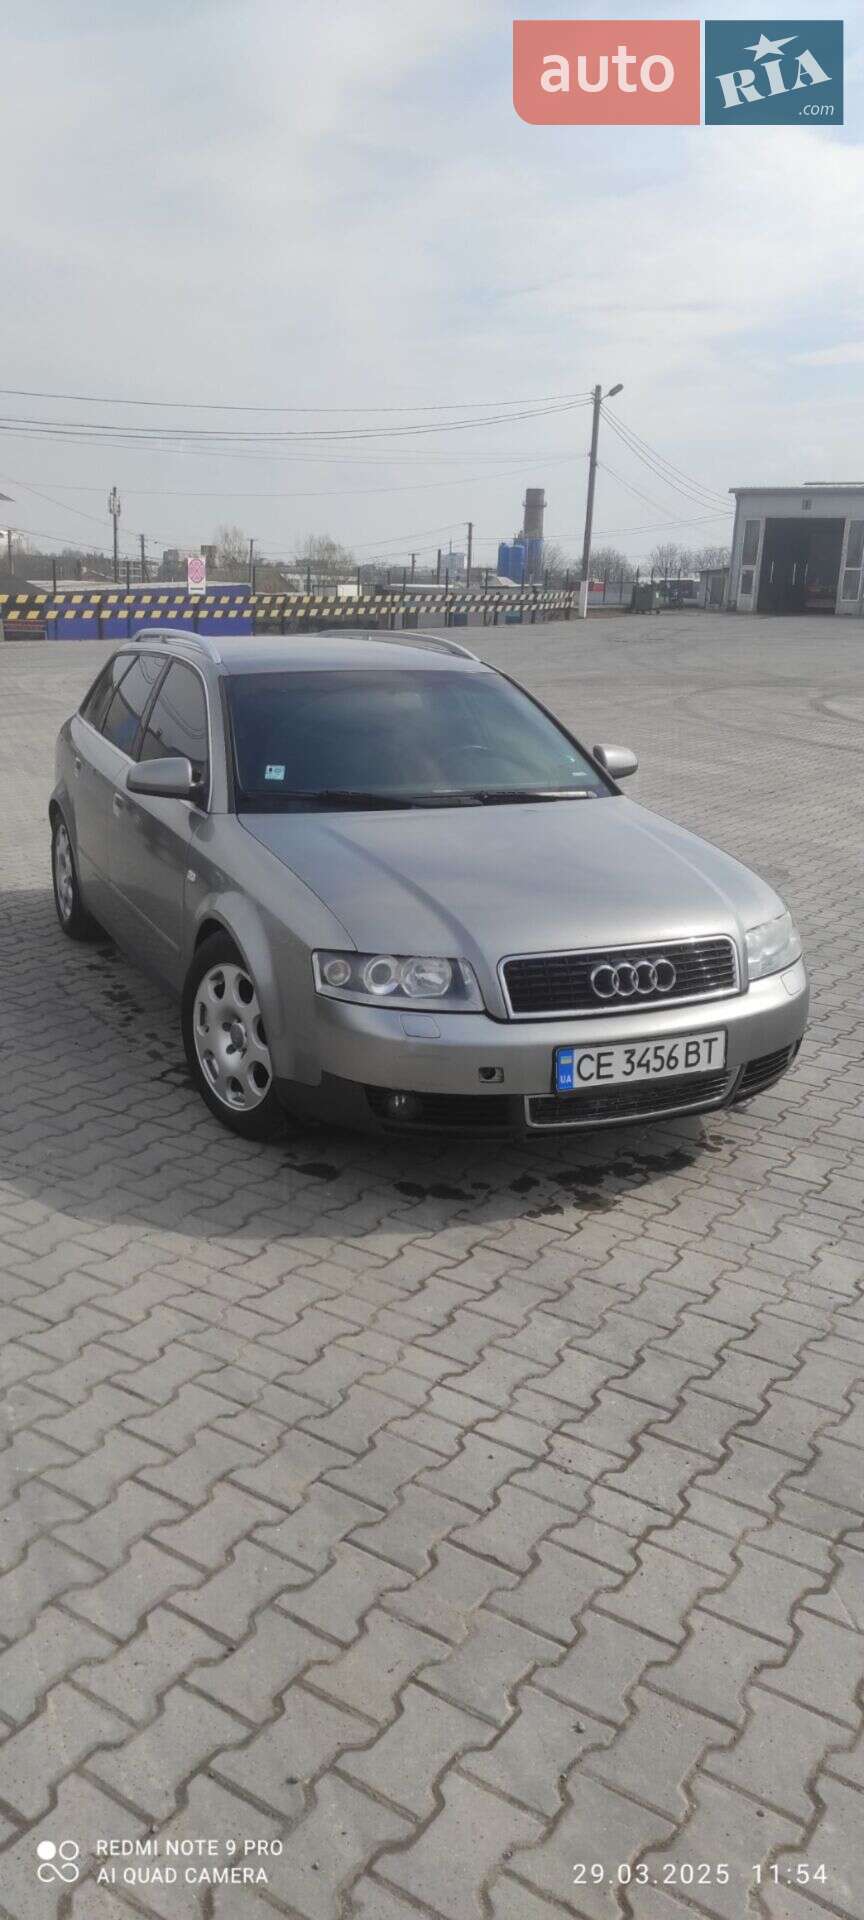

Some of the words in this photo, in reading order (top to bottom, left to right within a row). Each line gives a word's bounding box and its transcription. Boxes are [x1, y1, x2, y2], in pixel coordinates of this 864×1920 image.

[576, 1052, 615, 1081] CE
[622, 1043, 679, 1077] 3456
[684, 1037, 719, 1069] BT
[560, 1074, 572, 1084] UA
